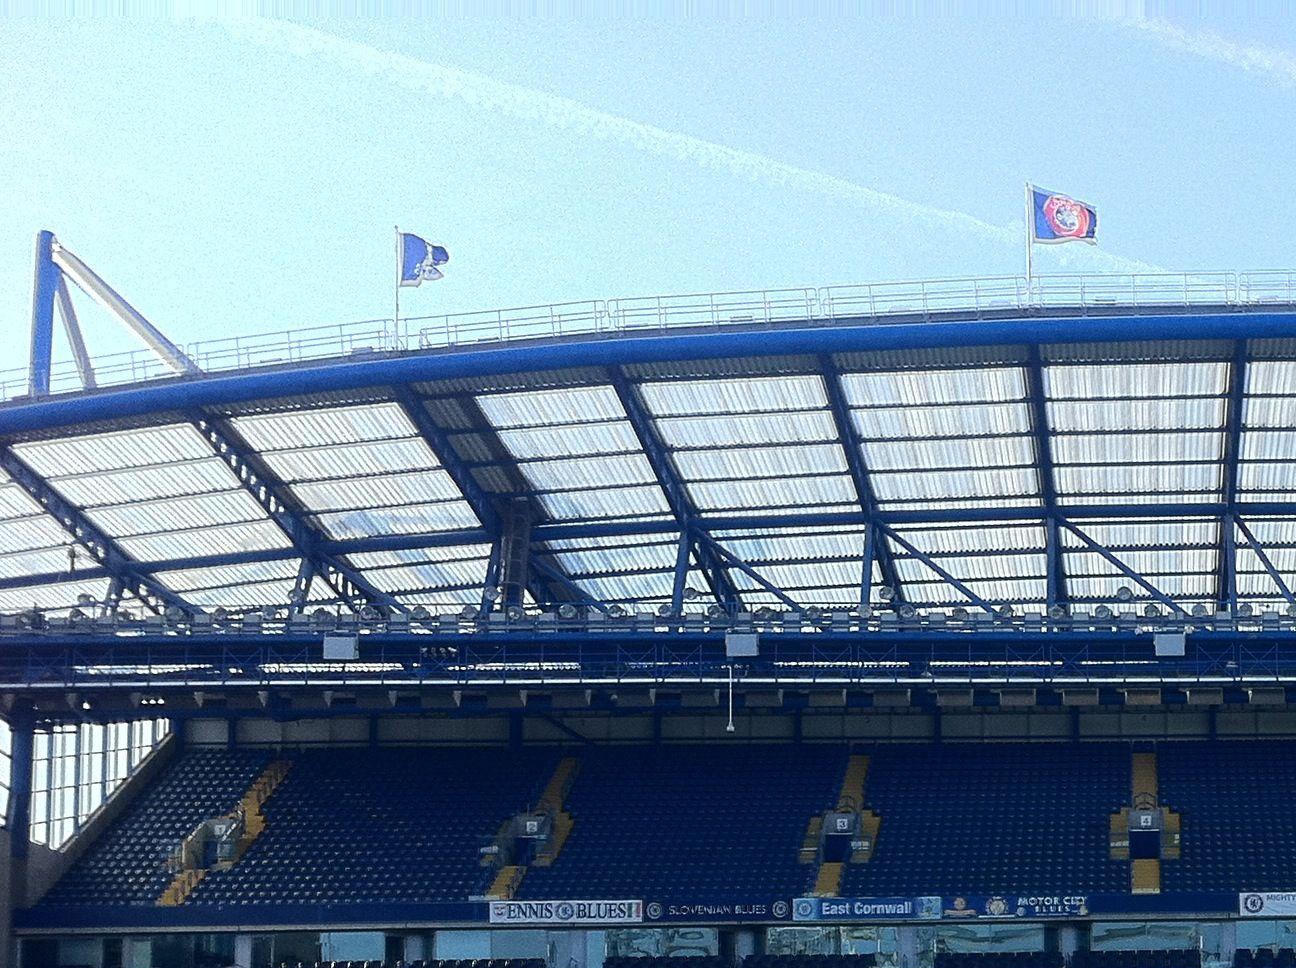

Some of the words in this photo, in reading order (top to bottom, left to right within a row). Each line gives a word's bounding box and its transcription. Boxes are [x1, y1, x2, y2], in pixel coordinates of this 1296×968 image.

[1018, 896, 1059, 906] MOTOR
[1063, 896, 1088, 906] CITY
[507, 903, 553, 919] ENNIS
[576, 903, 626, 919] BLUES
[669, 905, 731, 915] SLOVENIAN
[735, 905, 767, 914] BLUES
[822, 902, 852, 915] East
[854, 902, 912, 915] Cornwall
